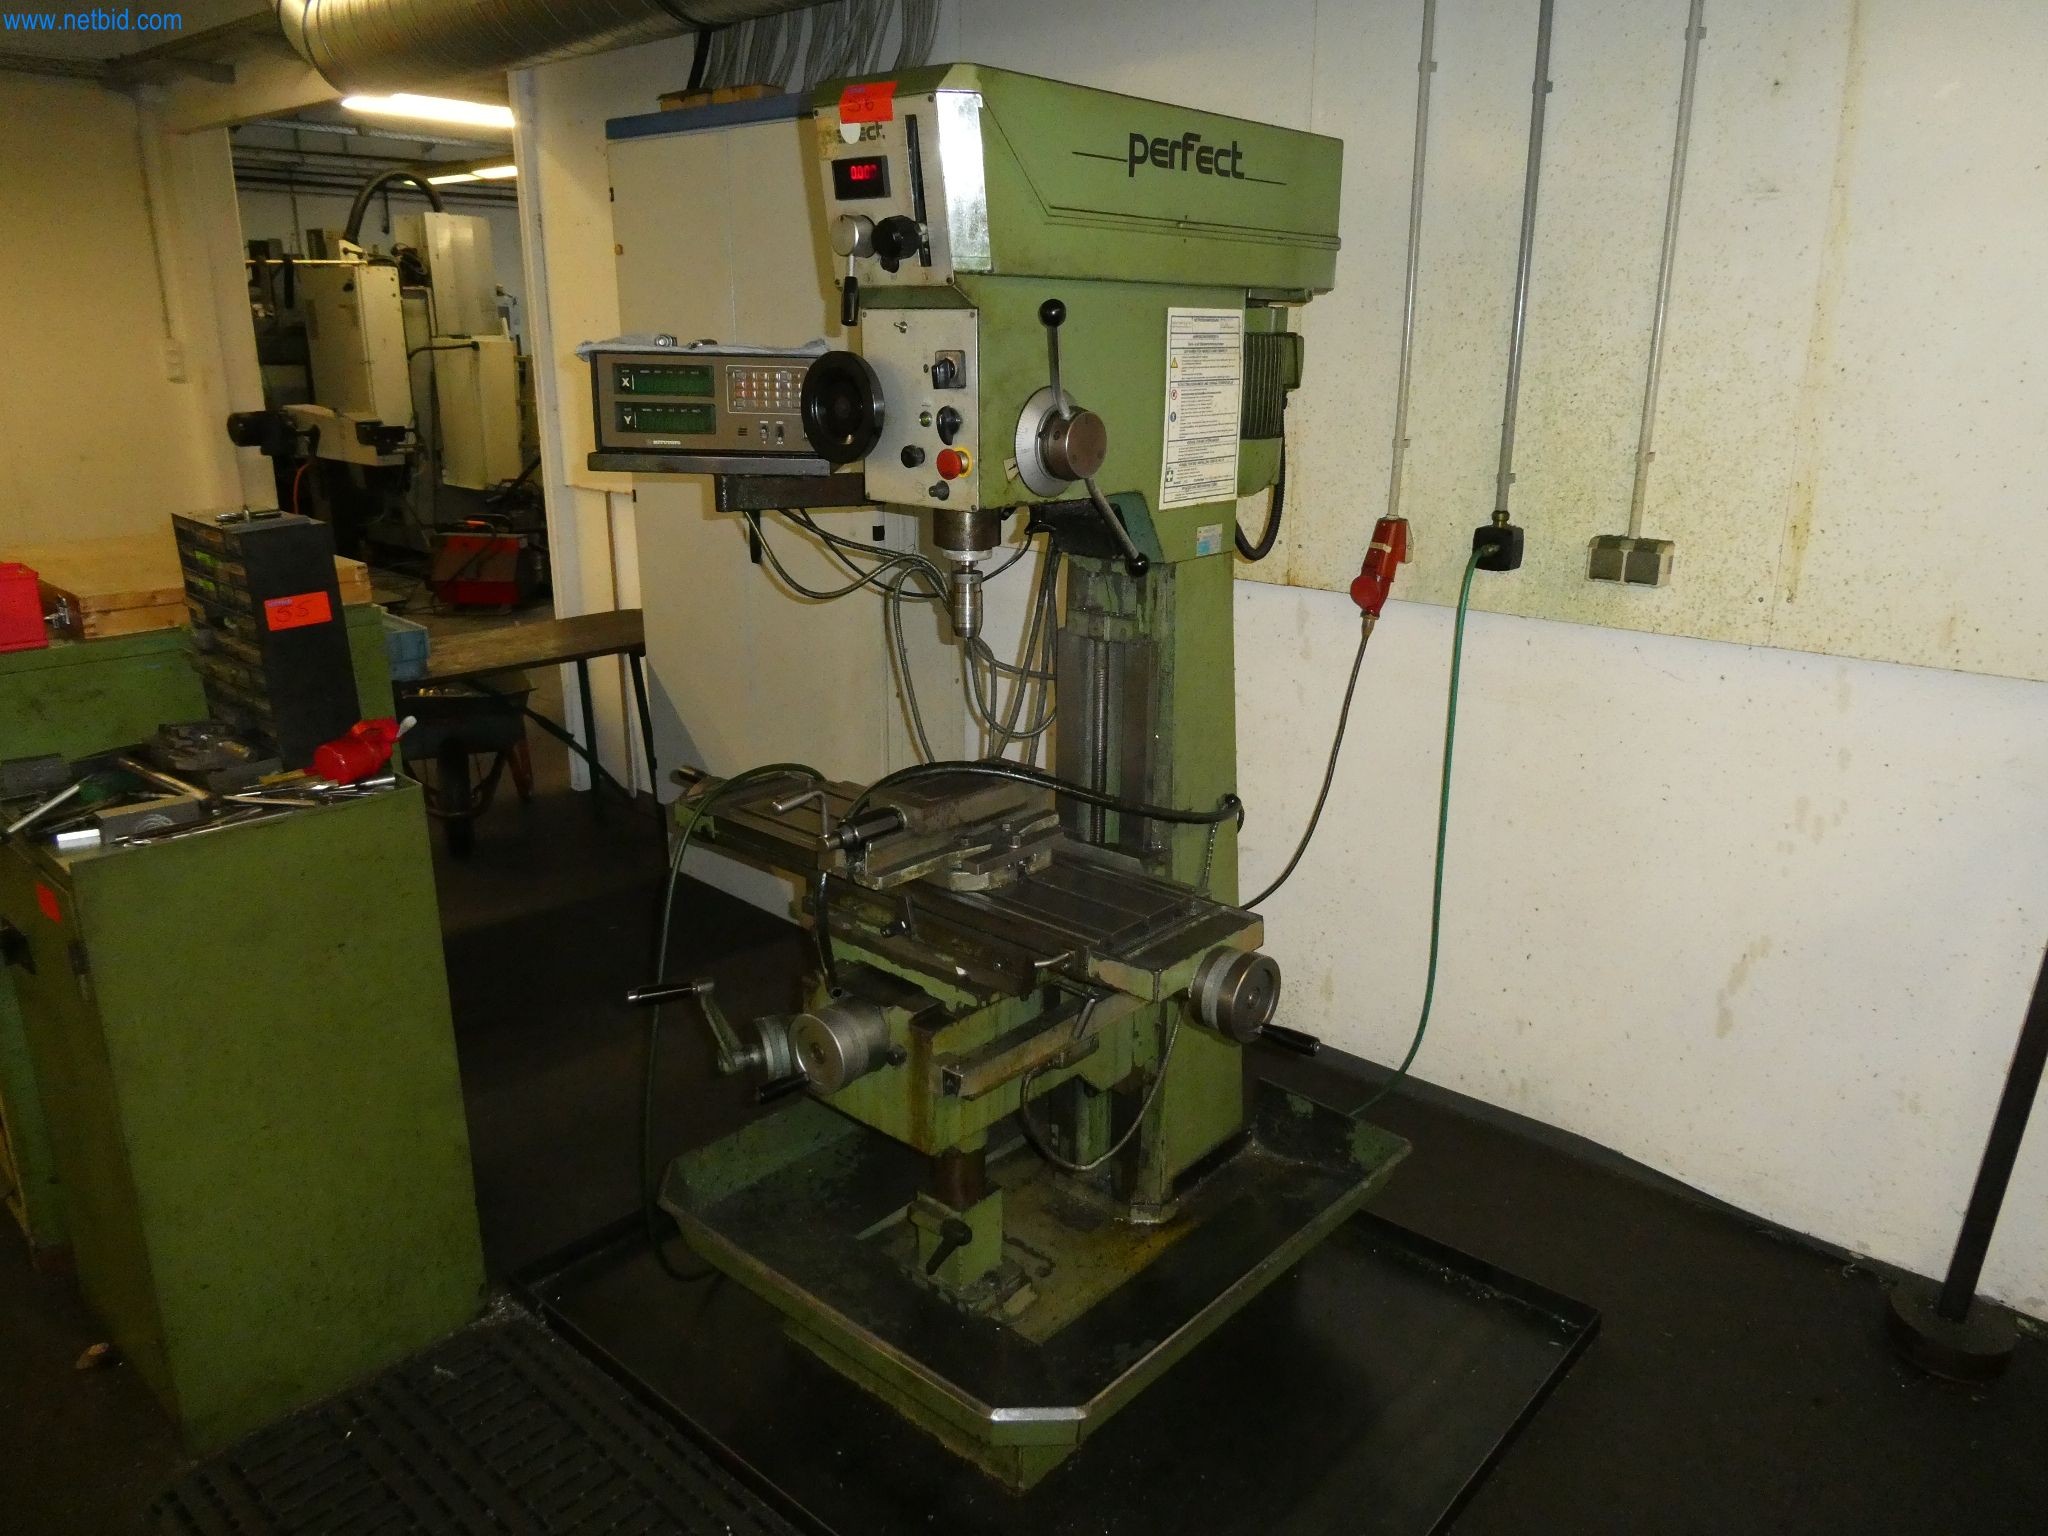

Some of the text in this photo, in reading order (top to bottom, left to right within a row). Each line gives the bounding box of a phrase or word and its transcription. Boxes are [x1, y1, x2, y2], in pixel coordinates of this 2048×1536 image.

[1128, 132, 1245, 180] perfect
[621, 377, 630, 387] X
[624, 415, 632, 425] Y
